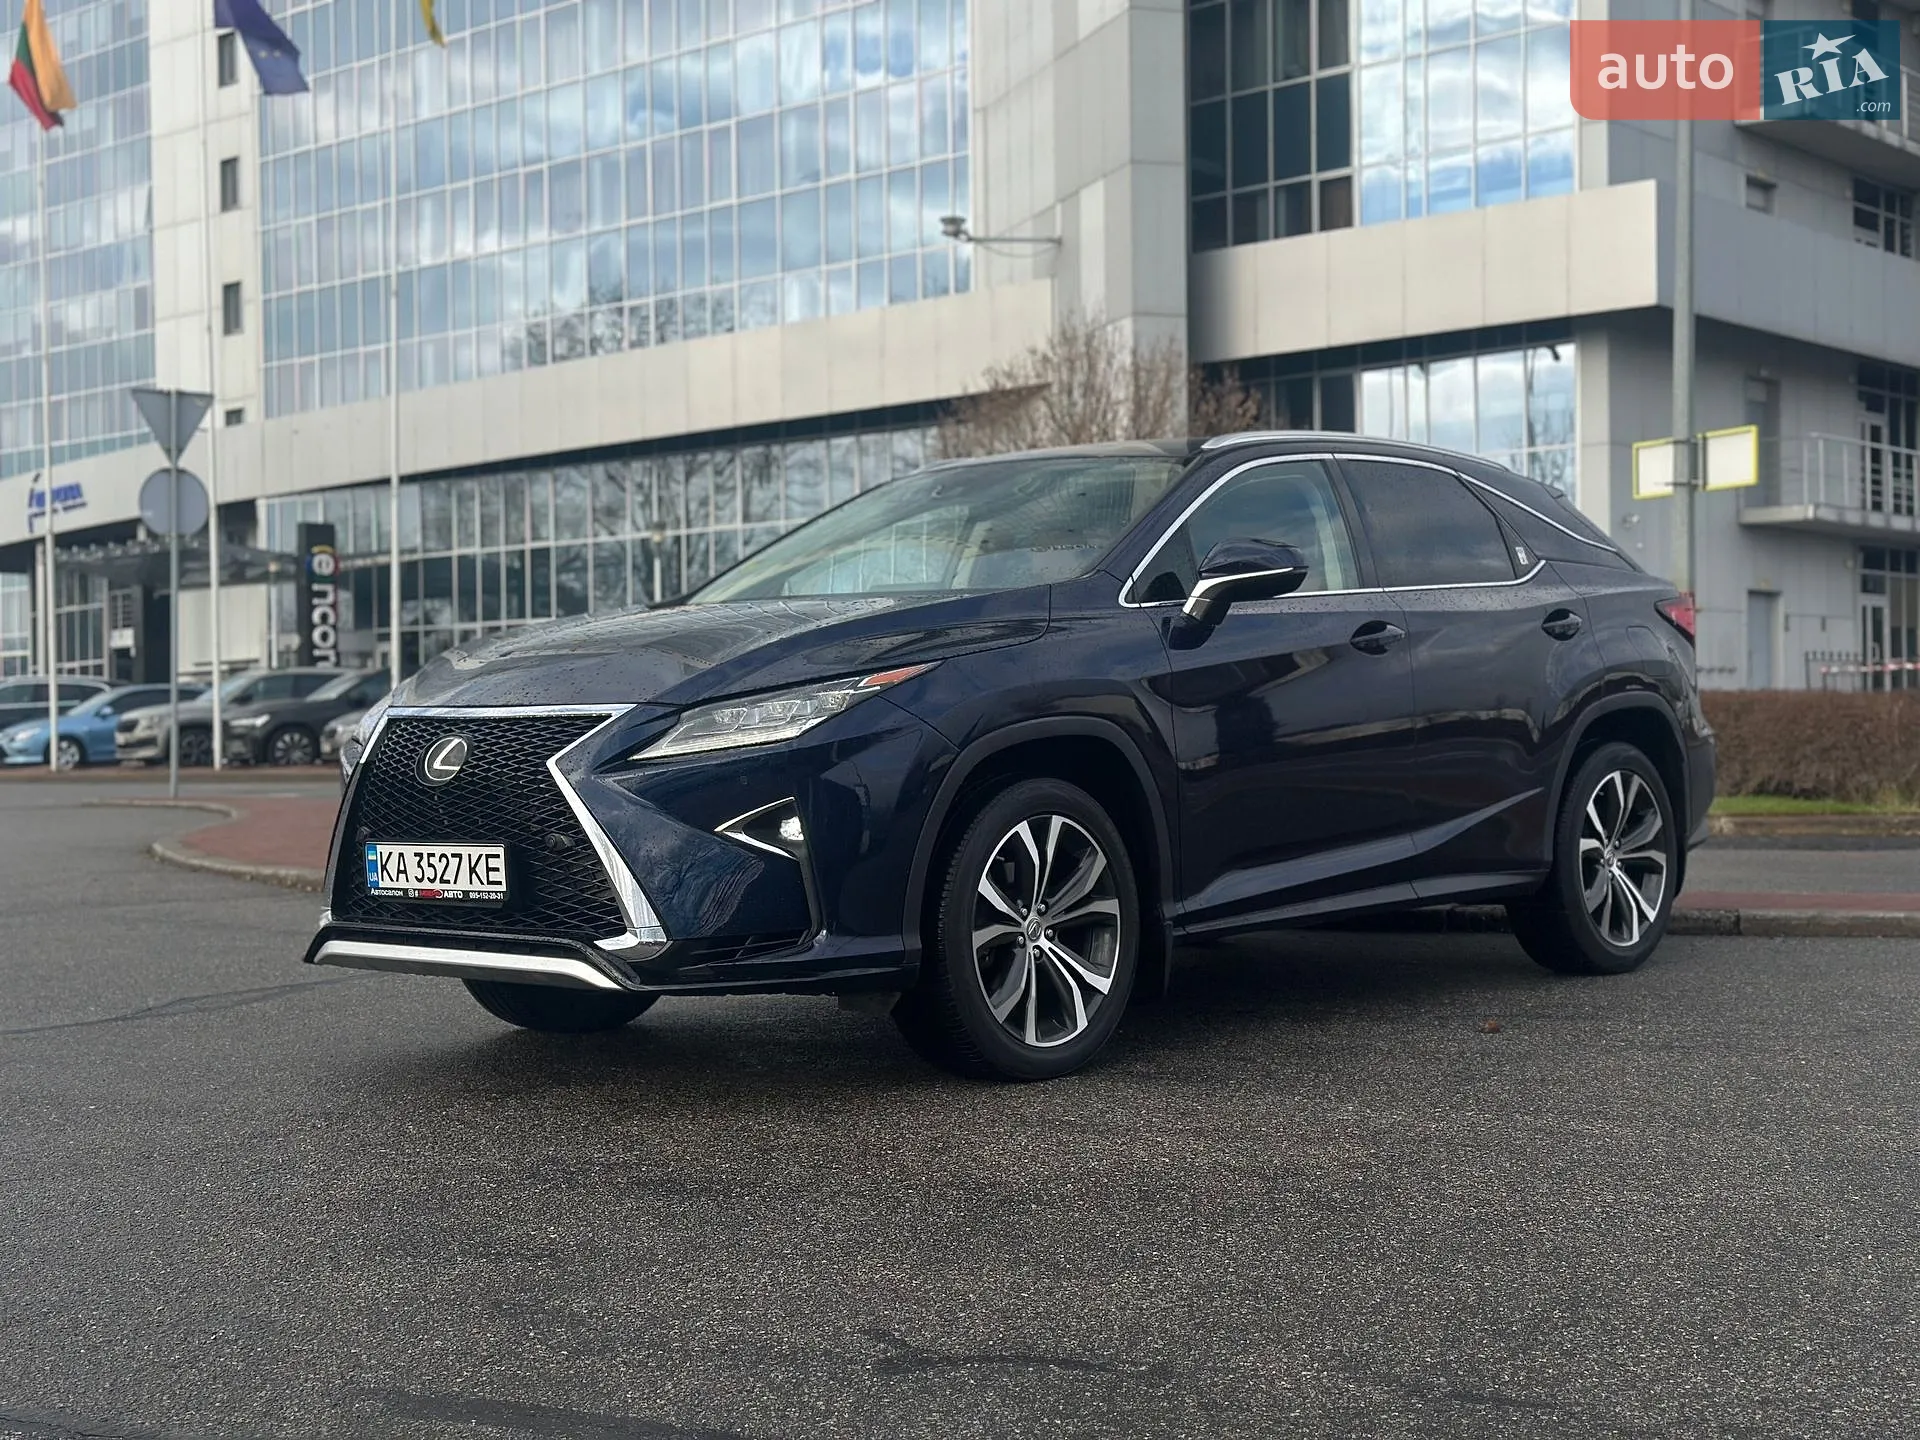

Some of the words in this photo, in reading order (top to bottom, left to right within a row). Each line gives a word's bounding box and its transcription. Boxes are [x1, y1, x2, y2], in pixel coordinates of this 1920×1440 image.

[311, 552, 337, 669] encor
[369, 872, 378, 882] UA
[379, 851, 409, 883] KA
[413, 852, 463, 884] 3527
[468, 853, 503, 886] KE
